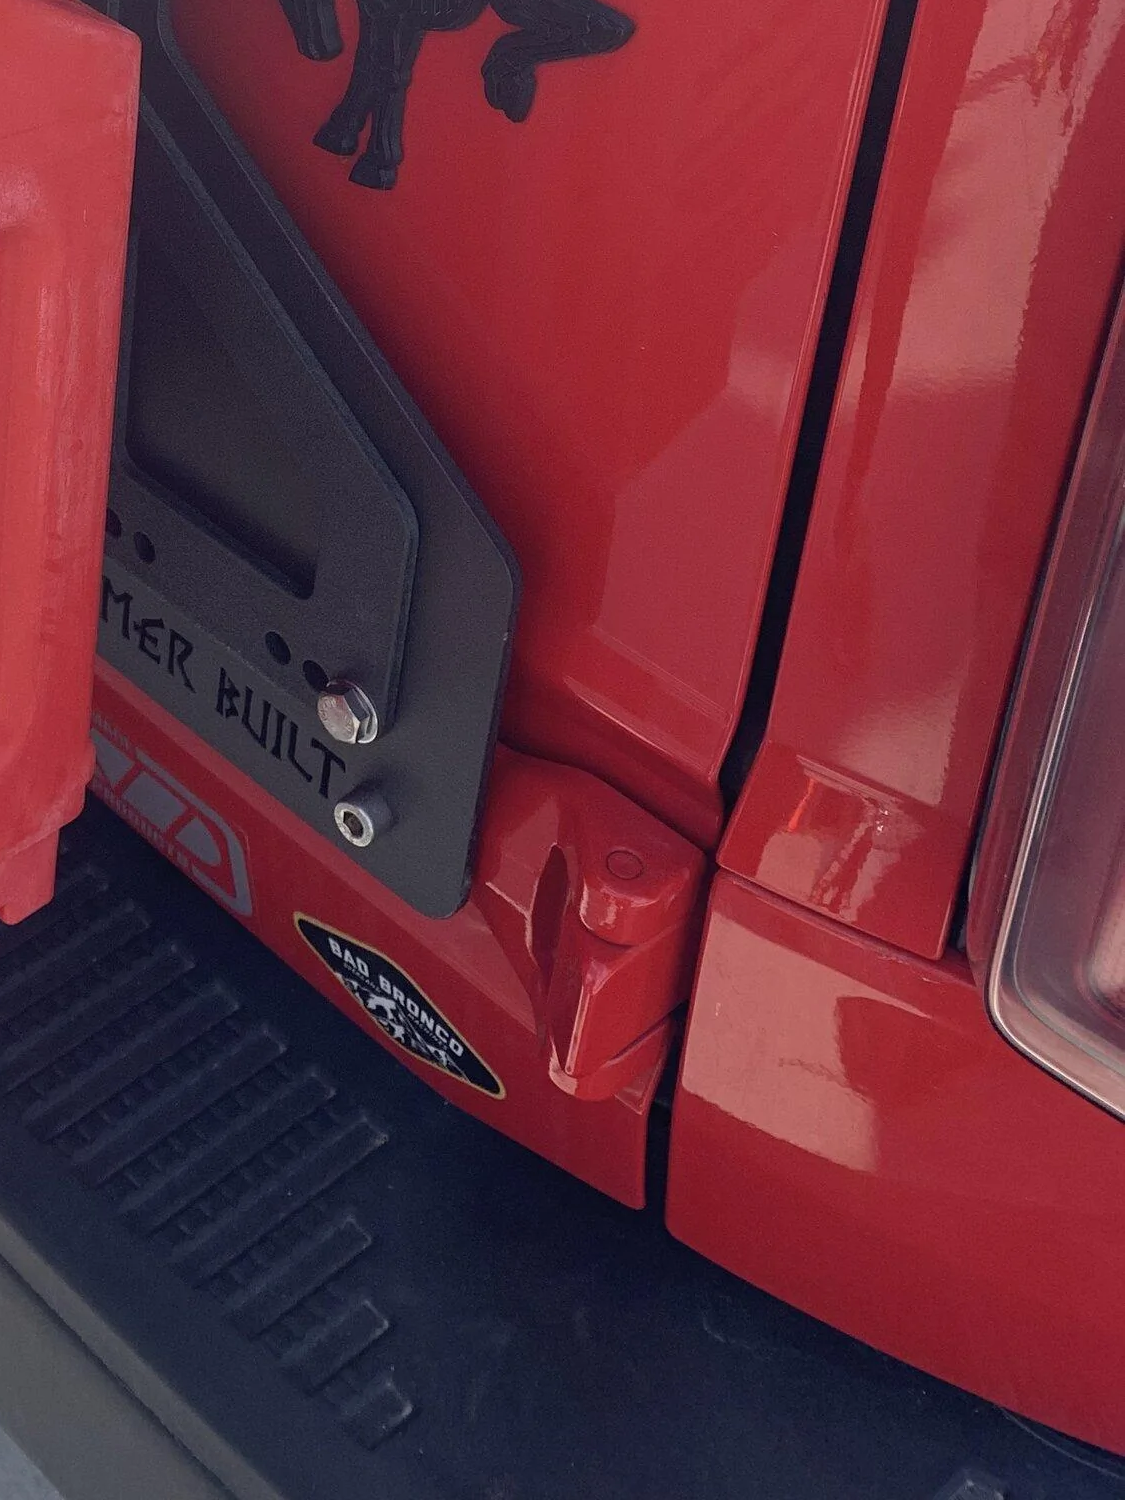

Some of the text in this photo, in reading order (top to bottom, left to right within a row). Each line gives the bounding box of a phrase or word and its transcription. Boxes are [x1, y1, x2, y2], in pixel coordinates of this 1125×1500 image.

[216, 667, 346, 798] BUILT
[328, 937, 370, 977] BAD
[379, 974, 464, 1057] BRONCO
